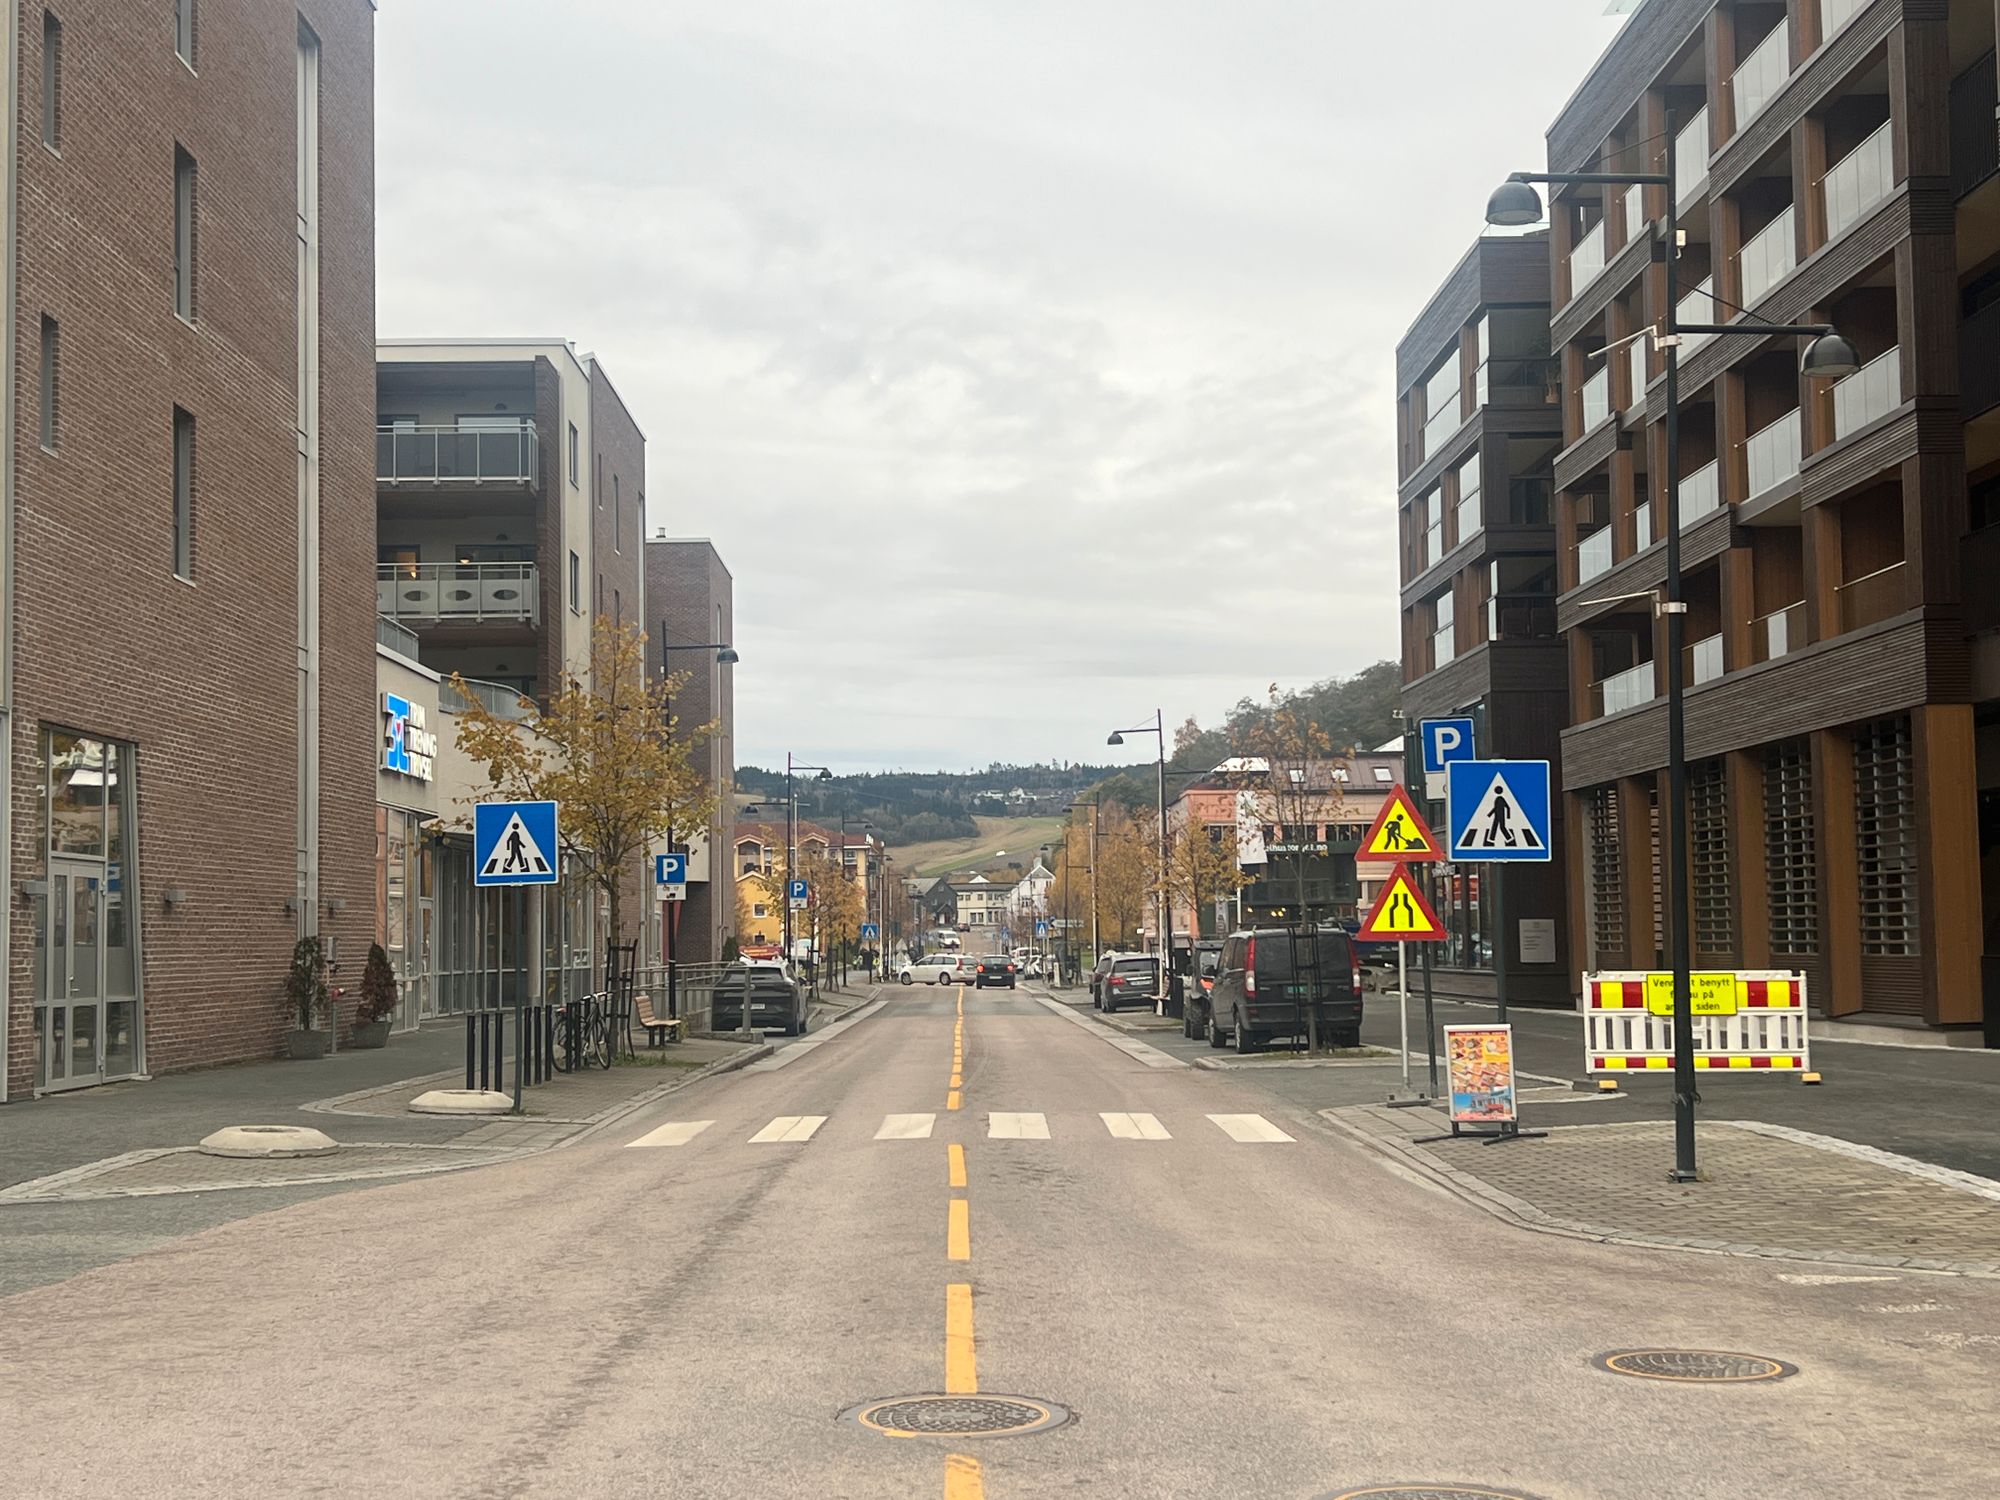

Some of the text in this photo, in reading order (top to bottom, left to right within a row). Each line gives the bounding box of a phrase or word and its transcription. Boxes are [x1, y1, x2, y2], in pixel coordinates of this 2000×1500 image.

[1434, 727, 1461, 765] P
[662, 858, 678, 880] P
[793, 882, 804, 897] P
[1699, 977, 1730, 988] benytt
[1703, 989, 1714, 1000] på
[1696, 1002, 1720, 1010] siden
